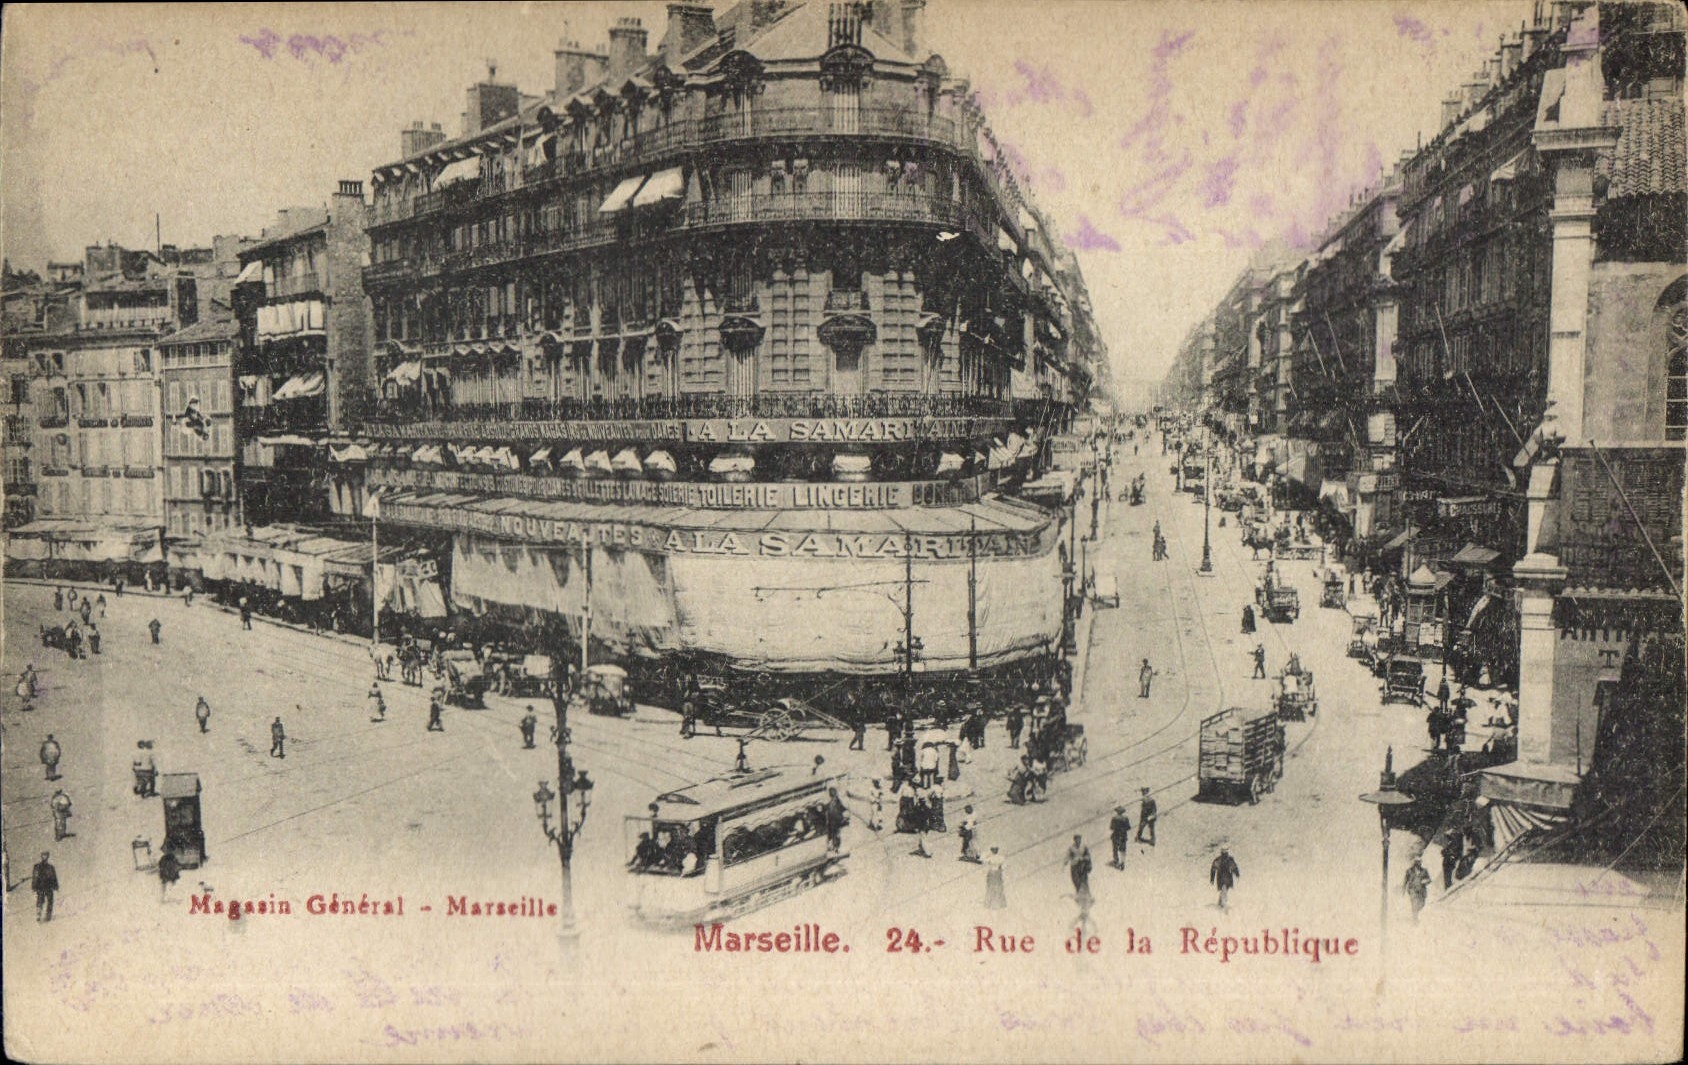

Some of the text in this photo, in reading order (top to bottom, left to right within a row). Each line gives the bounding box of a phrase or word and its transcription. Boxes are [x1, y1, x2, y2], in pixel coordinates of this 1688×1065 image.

[700, 420, 717, 441] A
[727, 420, 777, 441] LA
[699, 484, 777, 507] TOILERIE
[792, 485, 900, 507] LINGERIE
[690, 530, 750, 556] LA
